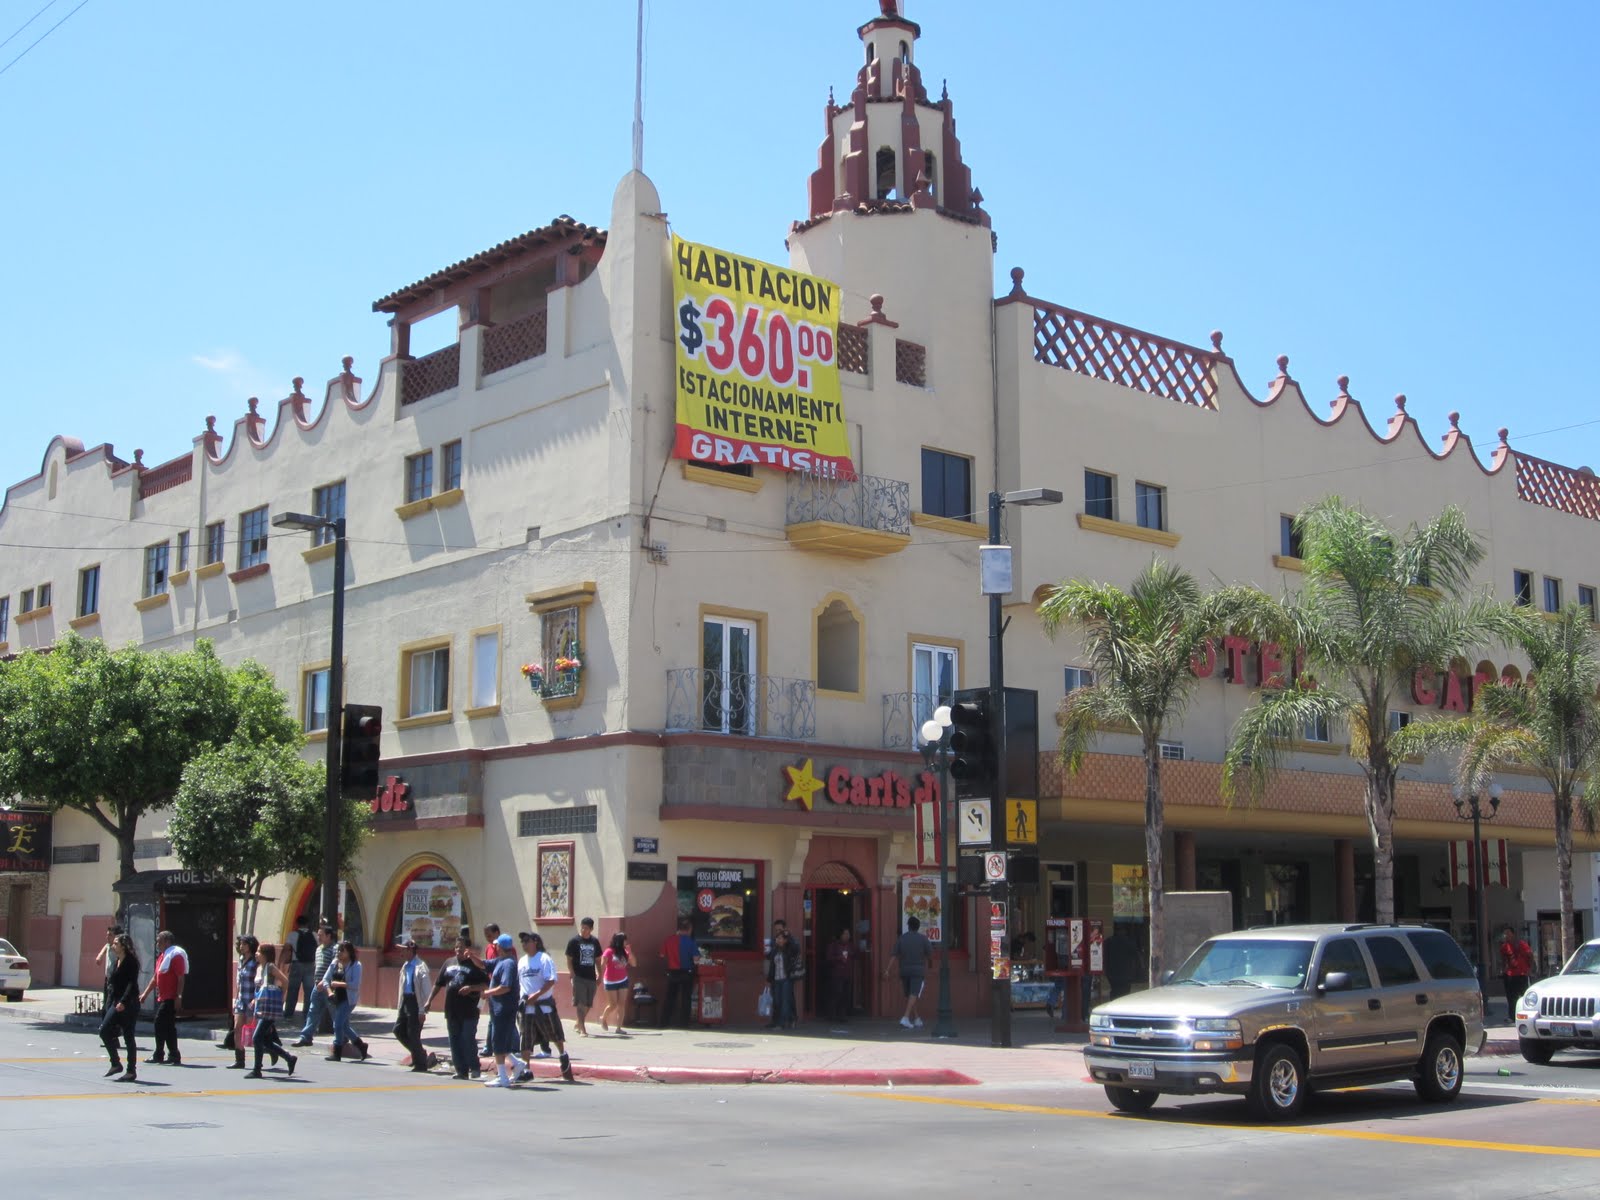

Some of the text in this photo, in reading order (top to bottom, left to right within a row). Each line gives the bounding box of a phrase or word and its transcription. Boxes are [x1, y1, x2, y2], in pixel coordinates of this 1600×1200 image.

[677, 242, 832, 315] HABITACION
[705, 404, 818, 446] INTERNET
[1186, 633, 1318, 690] OTEL
[828, 765, 912, 809] Carl's
[718, 870, 741, 882] GRANDE
